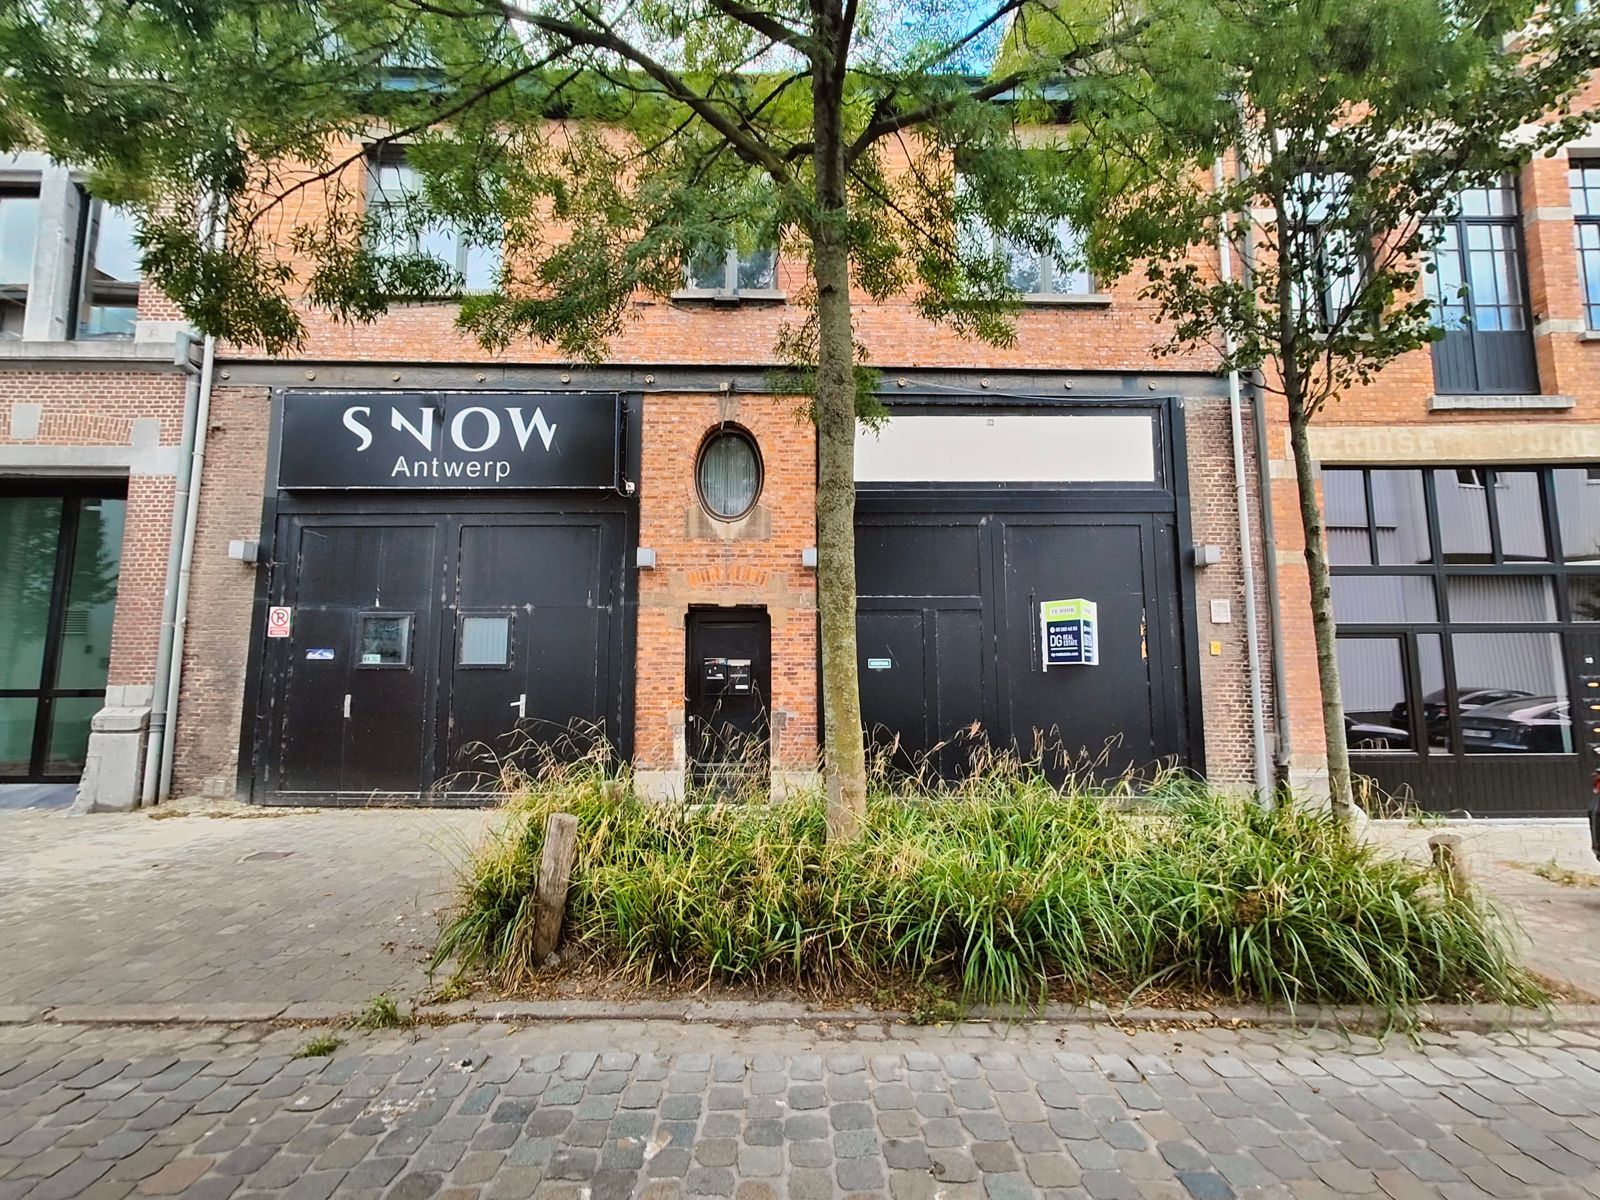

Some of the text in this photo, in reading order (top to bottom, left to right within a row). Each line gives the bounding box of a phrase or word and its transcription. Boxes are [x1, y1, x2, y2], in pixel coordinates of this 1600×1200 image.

[342, 406, 557, 452] SNOW
[391, 456, 511, 483] Antwerp
[1050, 635, 1062, 647] DG
